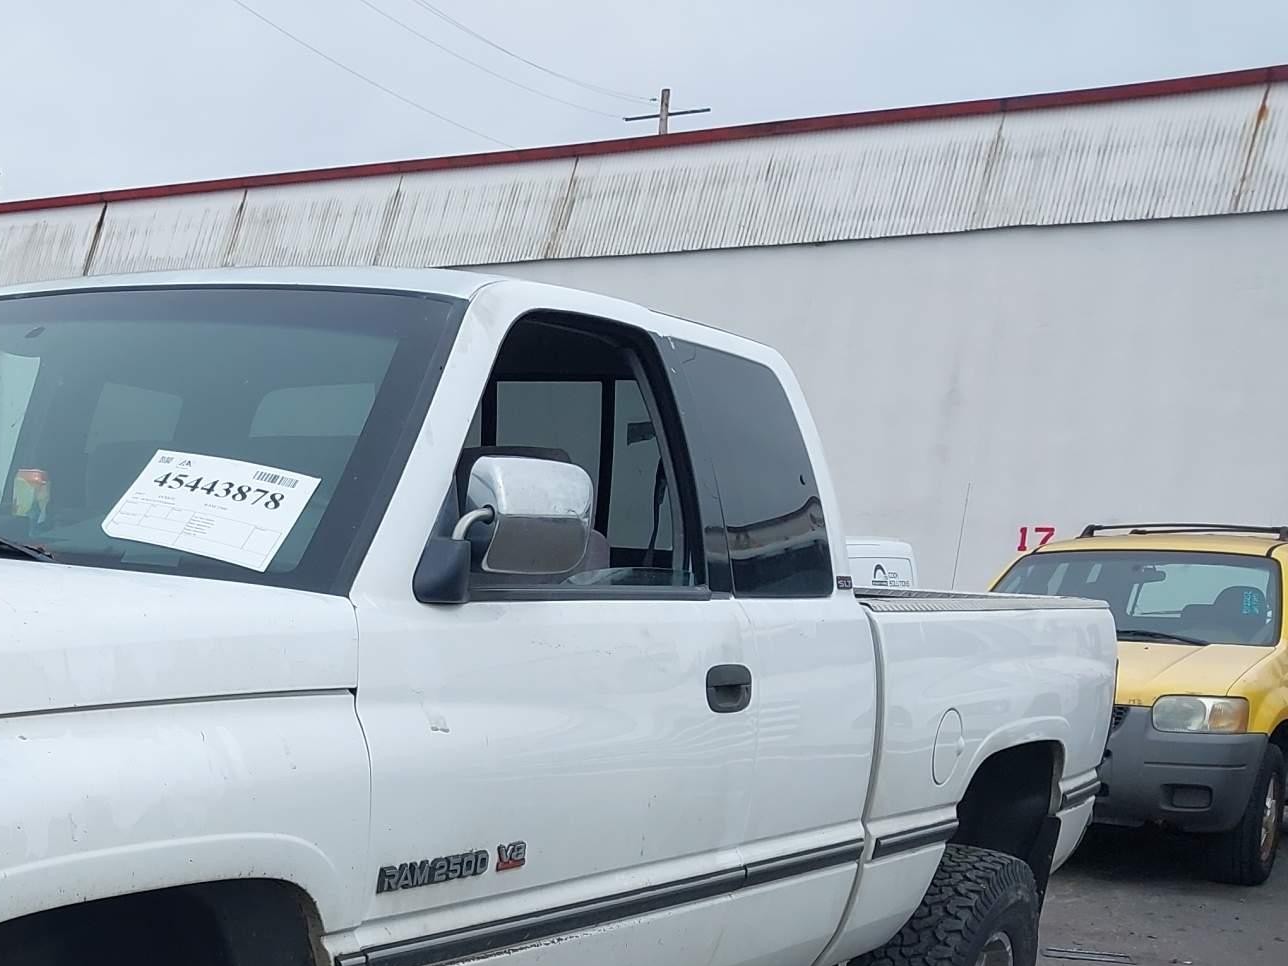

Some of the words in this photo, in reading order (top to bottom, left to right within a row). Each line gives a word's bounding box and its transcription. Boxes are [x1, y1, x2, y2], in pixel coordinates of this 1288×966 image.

[154, 471, 286, 511] 45443878
[1017, 527, 1055, 551] 17
[376, 859, 431, 893] RAM
[430, 850, 490, 882] 2500
[496, 841, 527, 871] V8
